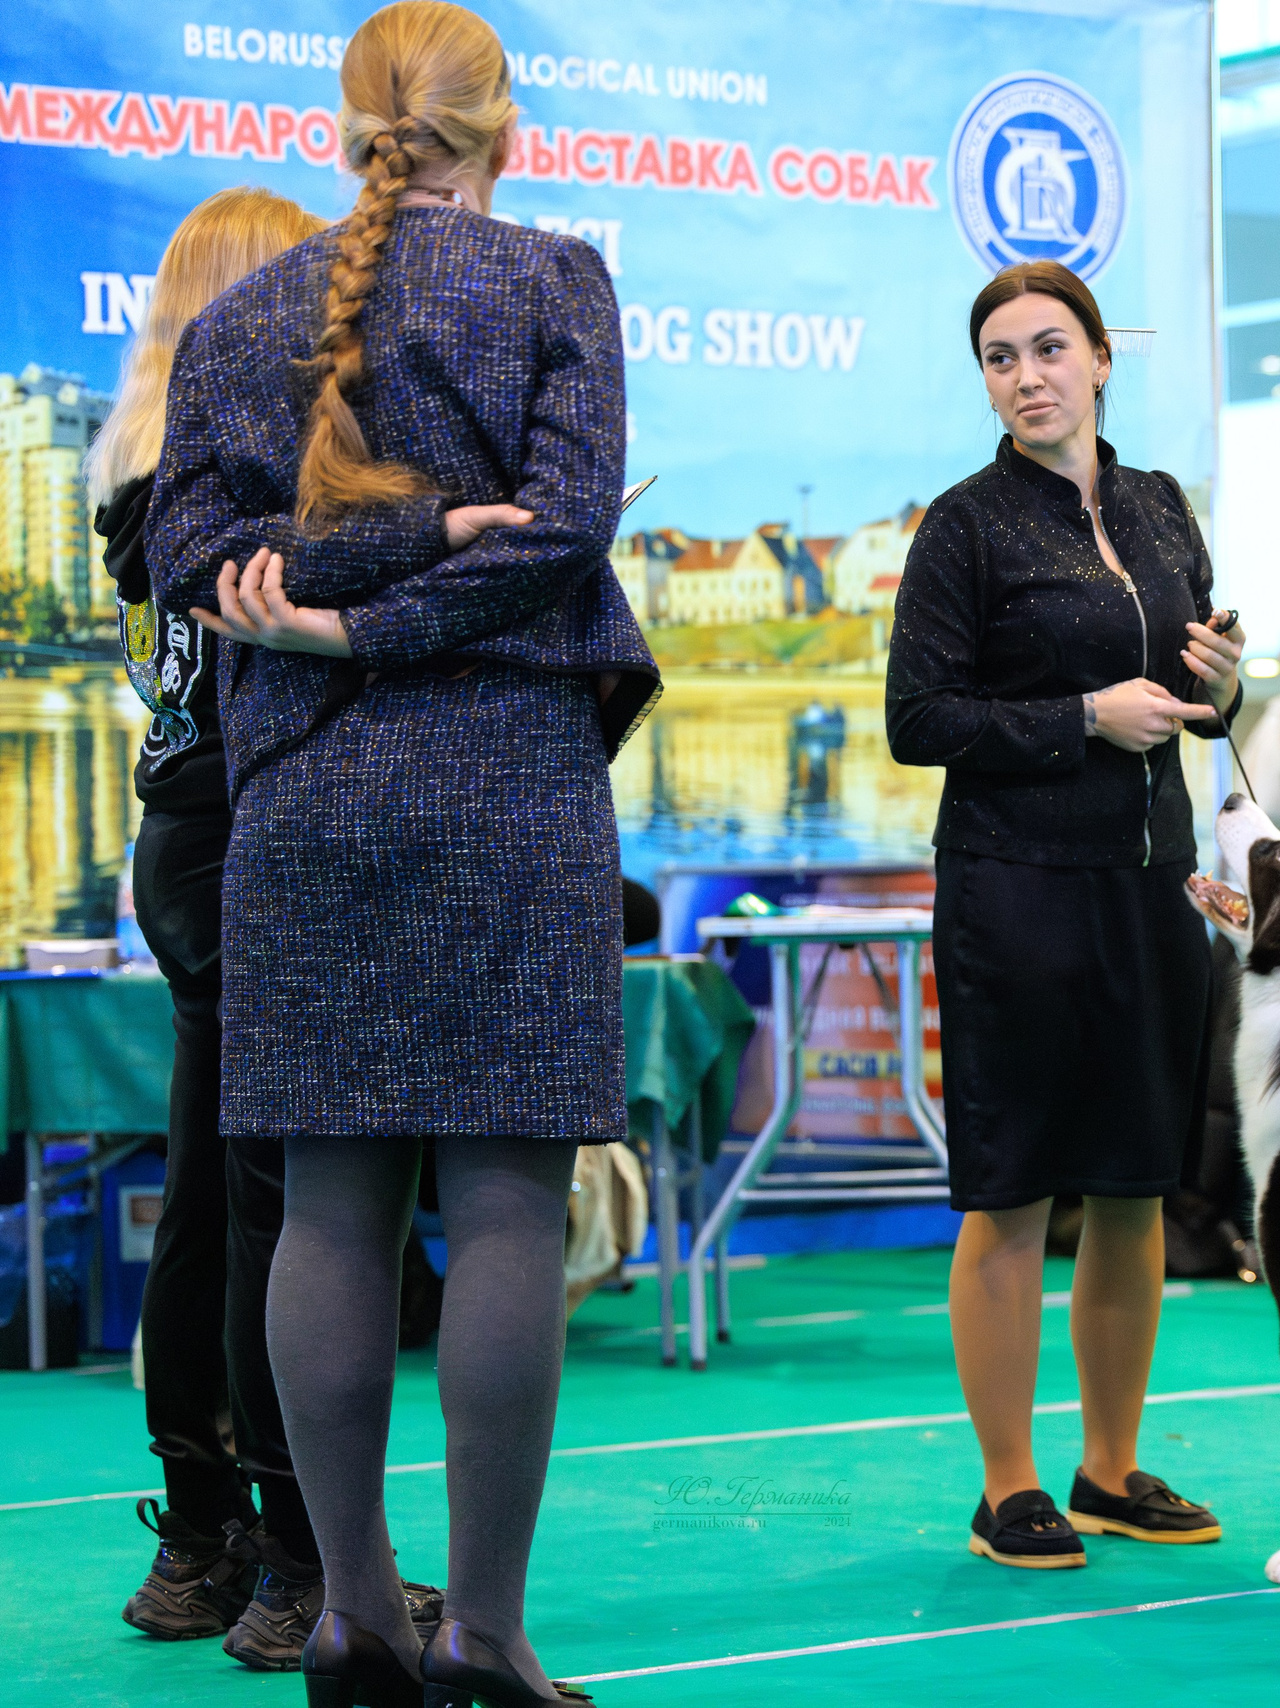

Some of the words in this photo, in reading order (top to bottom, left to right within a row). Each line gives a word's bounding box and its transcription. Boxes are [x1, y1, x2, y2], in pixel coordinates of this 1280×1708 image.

[184, 24, 351, 71] BELORUSS
[667, 66, 767, 107] UNION
[0, 82, 346, 174] МЕЖДУНАРО
[769, 146, 939, 210] СОБАК
[703, 308, 864, 372] SHOW
